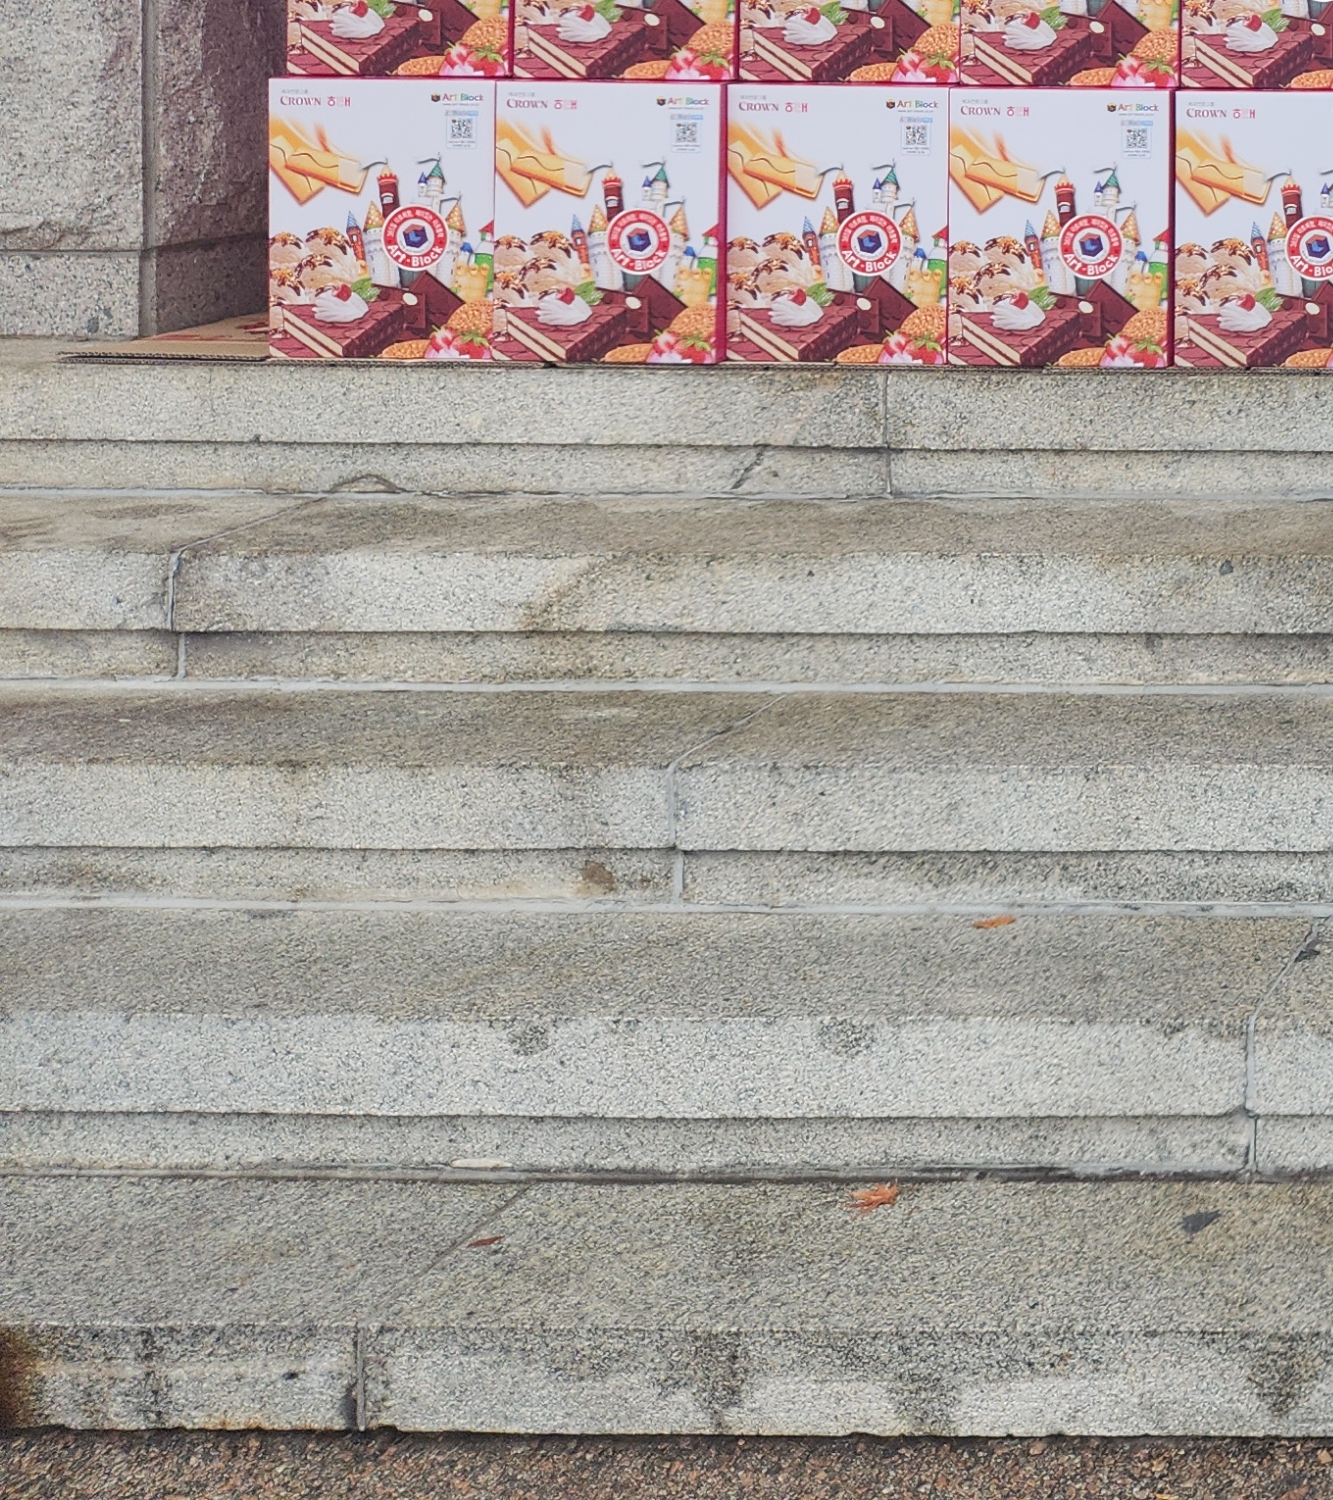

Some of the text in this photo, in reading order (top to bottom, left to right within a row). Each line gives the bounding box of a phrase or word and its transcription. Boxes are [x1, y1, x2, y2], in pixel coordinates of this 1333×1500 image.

[279, 95, 321, 105] CROWN
[441, 92, 484, 101] Art Block
[738, 101, 778, 111] CROWN
[896, 99, 939, 108] Art Block
[960, 105, 1000, 115] CROWN
[1186, 107, 1227, 118] CROWN
